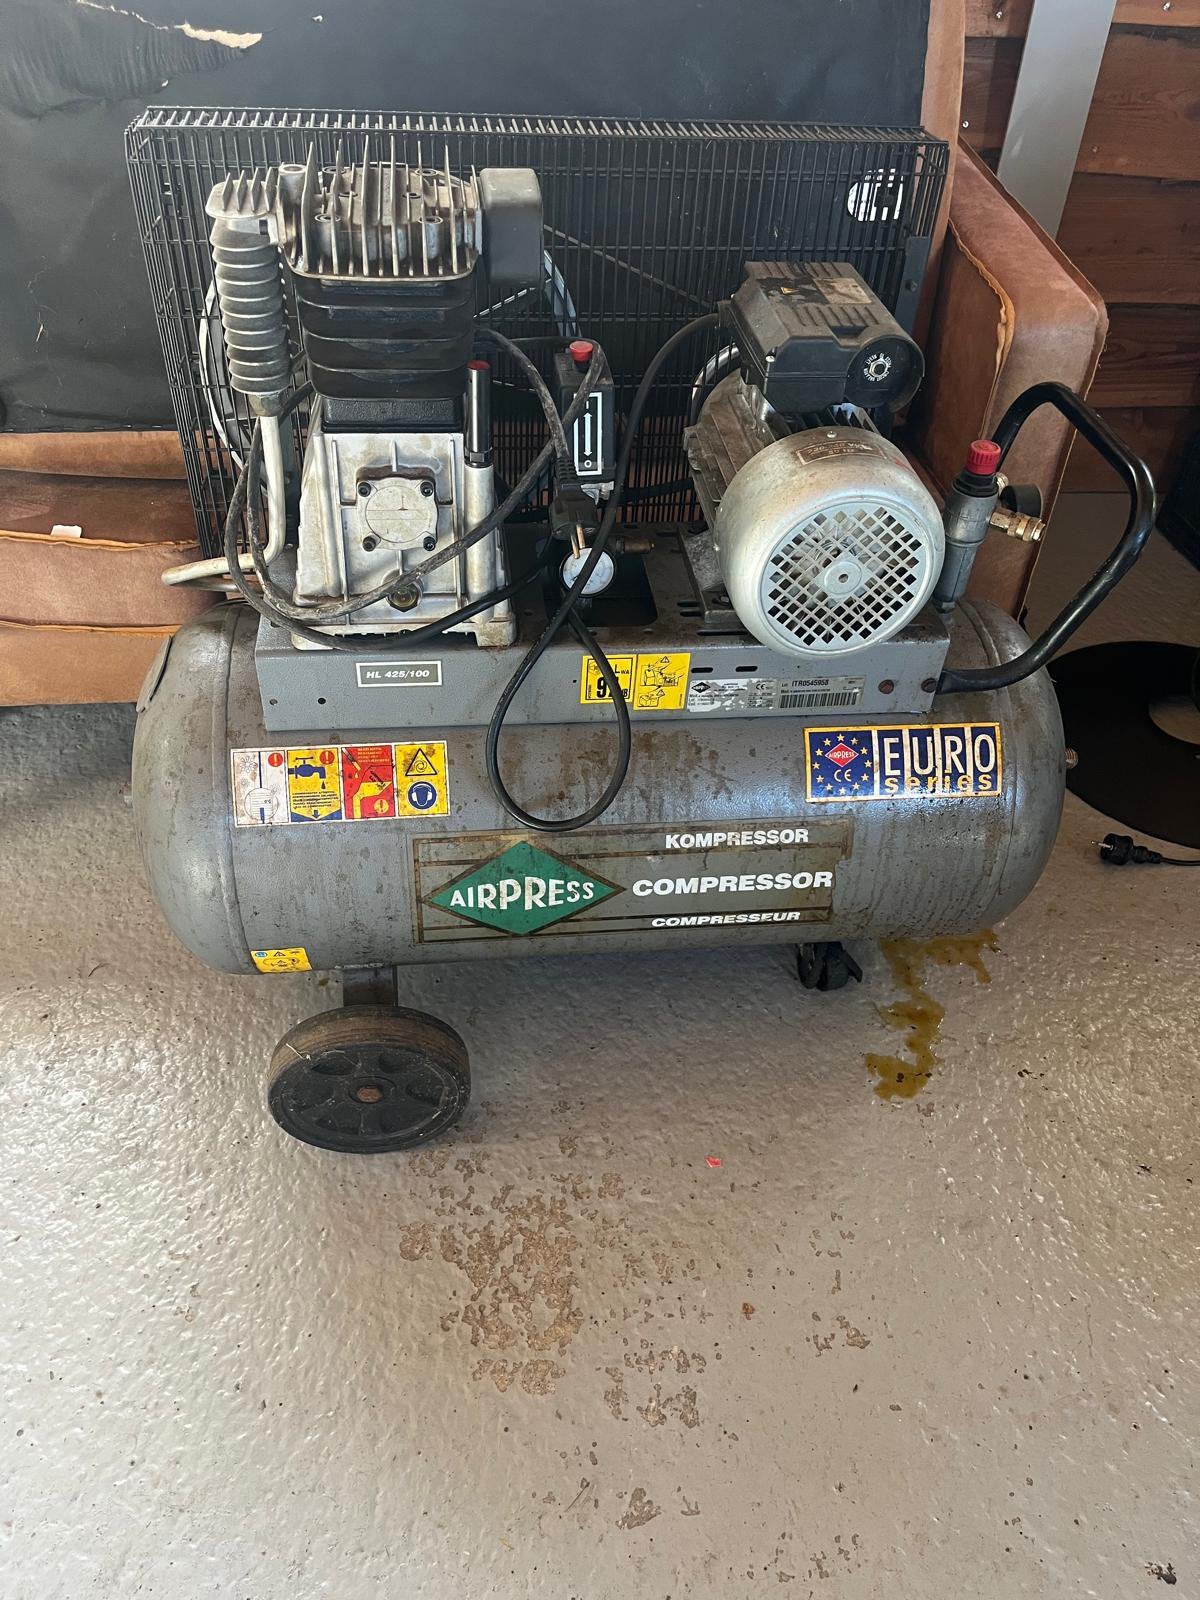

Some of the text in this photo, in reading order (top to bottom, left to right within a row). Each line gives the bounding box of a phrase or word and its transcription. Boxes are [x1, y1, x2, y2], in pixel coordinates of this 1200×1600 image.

[366, 669, 431, 679] HL 425/100
[883, 733, 996, 776] EURO
[884, 768, 993, 794] series
[665, 828, 809, 849] KOMPRESSOR
[449, 876, 596, 911] AIRPRESS
[632, 871, 834, 897] COMPRESSOR
[651, 911, 801, 928] COMPRESSEUR
